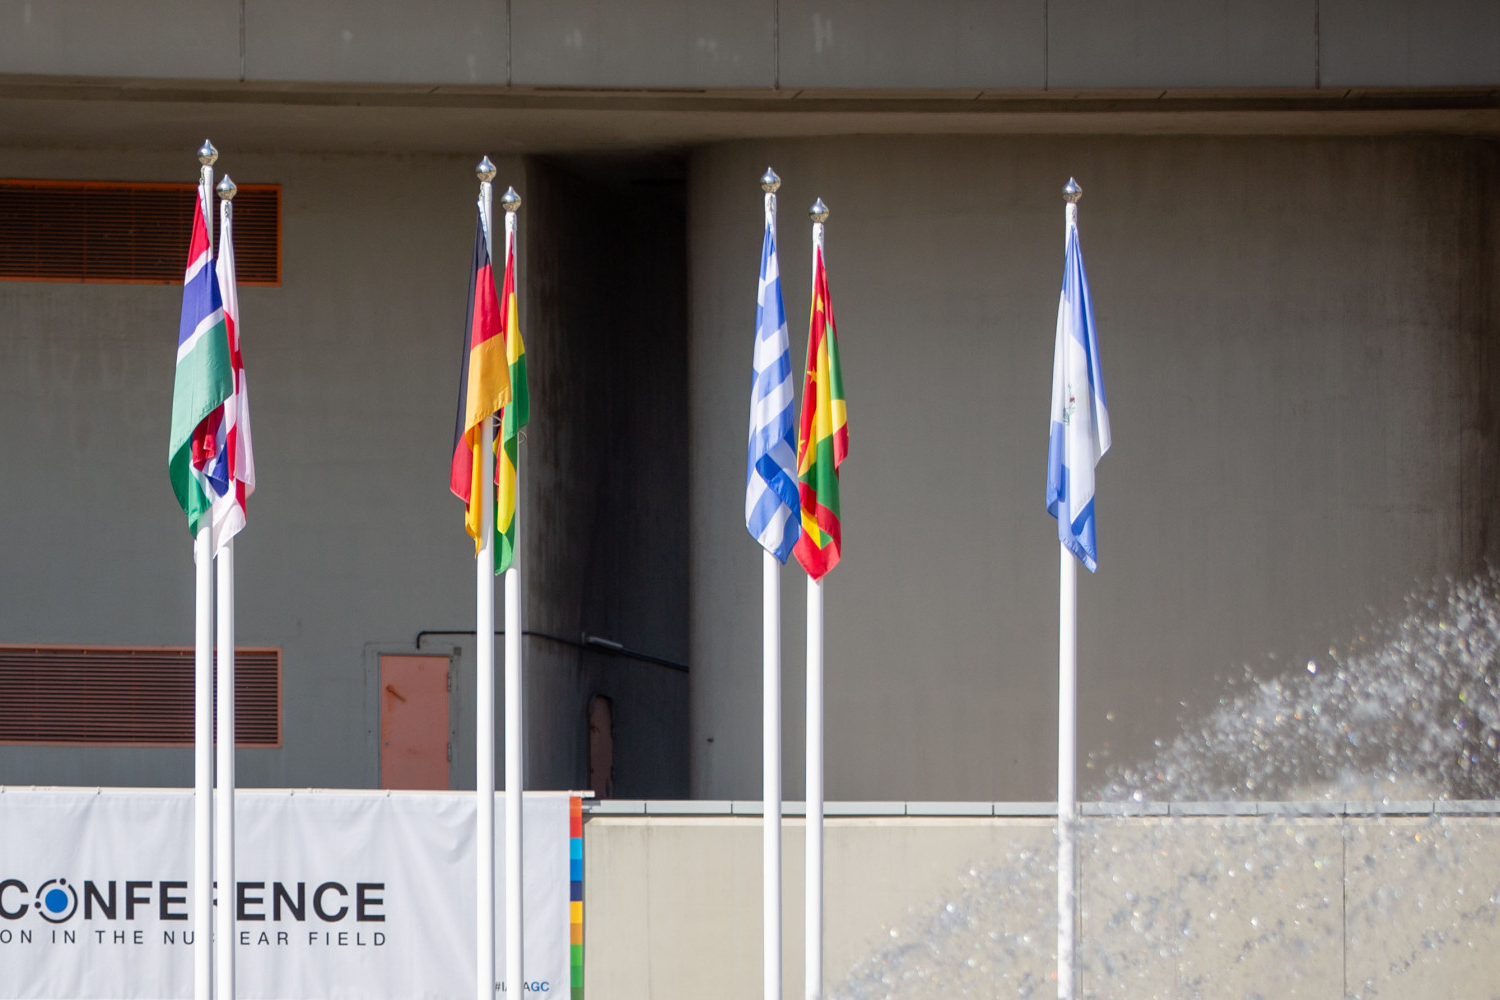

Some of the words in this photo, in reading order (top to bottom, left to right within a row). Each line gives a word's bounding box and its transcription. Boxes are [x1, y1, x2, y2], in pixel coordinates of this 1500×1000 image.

[51, 930, 76, 944] IN
[95, 930, 144, 945] THE
[163, 930, 289, 946] NUEAR
[308, 931, 386, 946] FIELD
[495, 981, 550, 993] #IAGC
